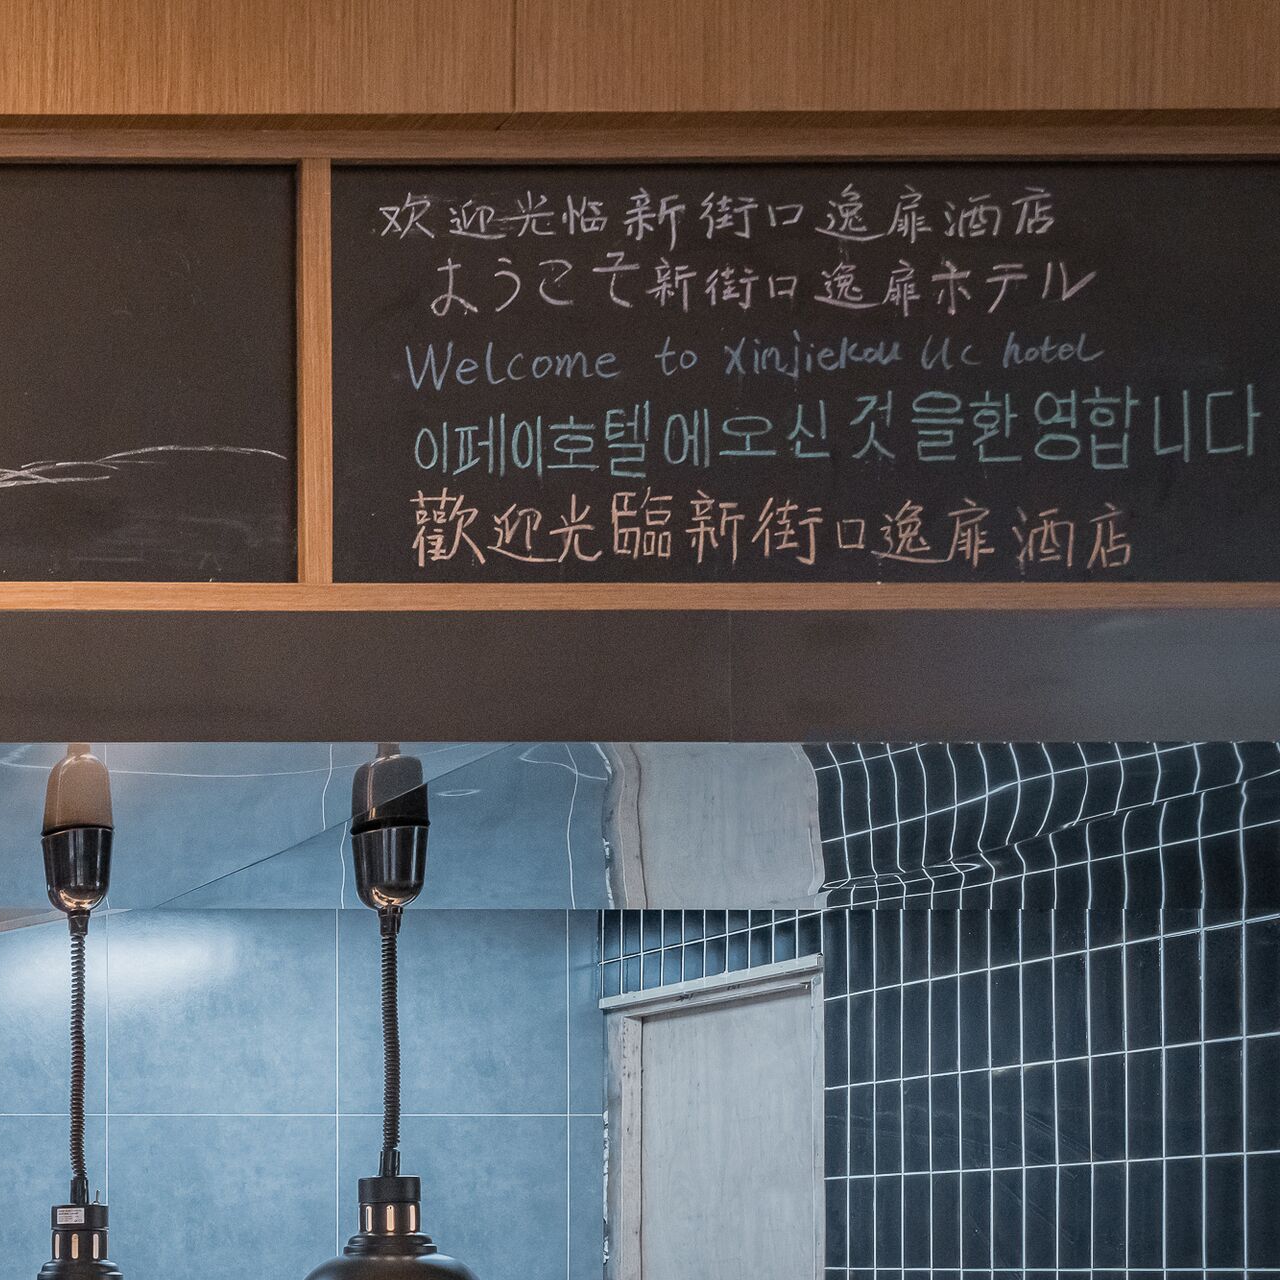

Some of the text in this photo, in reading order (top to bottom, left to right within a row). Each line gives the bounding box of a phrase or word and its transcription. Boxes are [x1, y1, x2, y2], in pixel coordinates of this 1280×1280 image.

[379, 183, 1056, 250] 欢迎光临新街口逸扉酒店
[405, 341, 622, 391] Welcome
[655, 336, 698, 376] to
[1002, 331, 1106, 369] hotel
[409, 487, 1132, 569] 歡迎光臨新街口逸扉酒店
